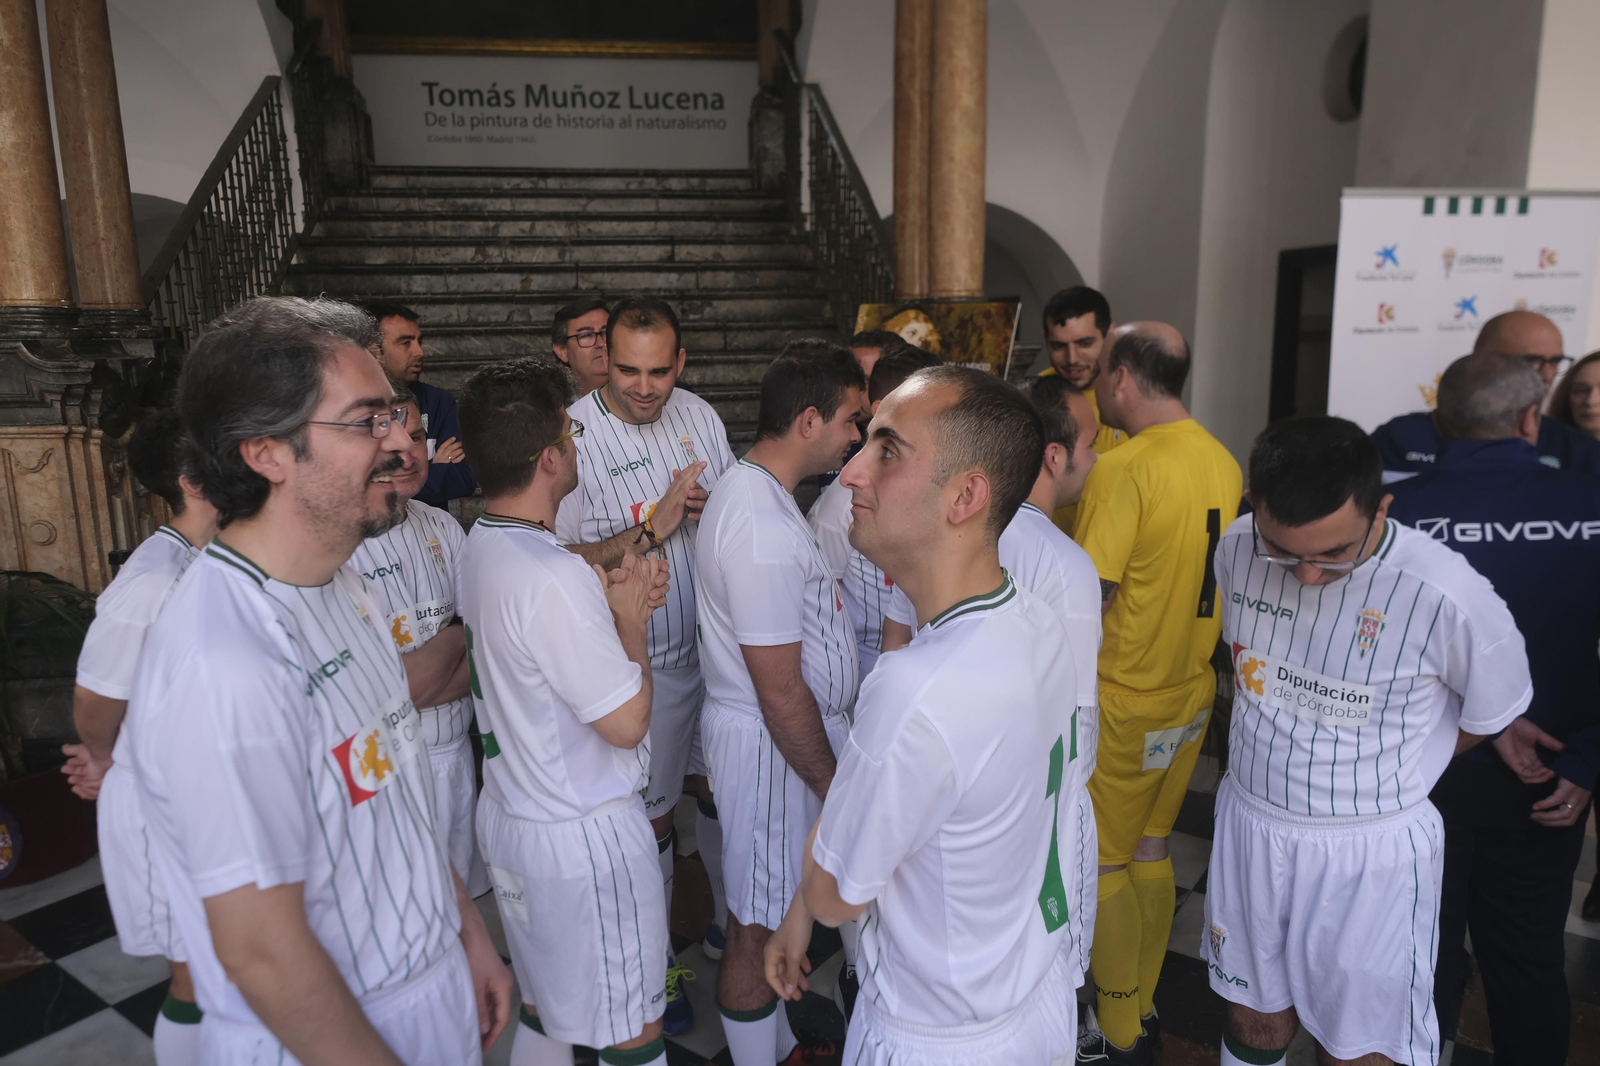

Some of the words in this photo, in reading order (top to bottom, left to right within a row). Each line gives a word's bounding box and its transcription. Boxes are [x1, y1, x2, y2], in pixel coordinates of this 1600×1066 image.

[421, 81, 516, 107] Tomás
[524, 83, 621, 109] Muñoz
[628, 84, 725, 110] Lucena
[424, 111, 447, 127] De
[451, 111, 465, 127] la
[470, 112, 528, 130] pintura
[532, 113, 552, 128] de
[556, 113, 615, 129] historia
[618, 114, 632, 129] al
[636, 115, 727, 130] naturalismo
[1232, 592, 1293, 621] GIVOVA
[1277, 666, 1370, 705] Diputación
[1273, 685, 1292, 702] de
[1296, 693, 1368, 719] Córdoba
